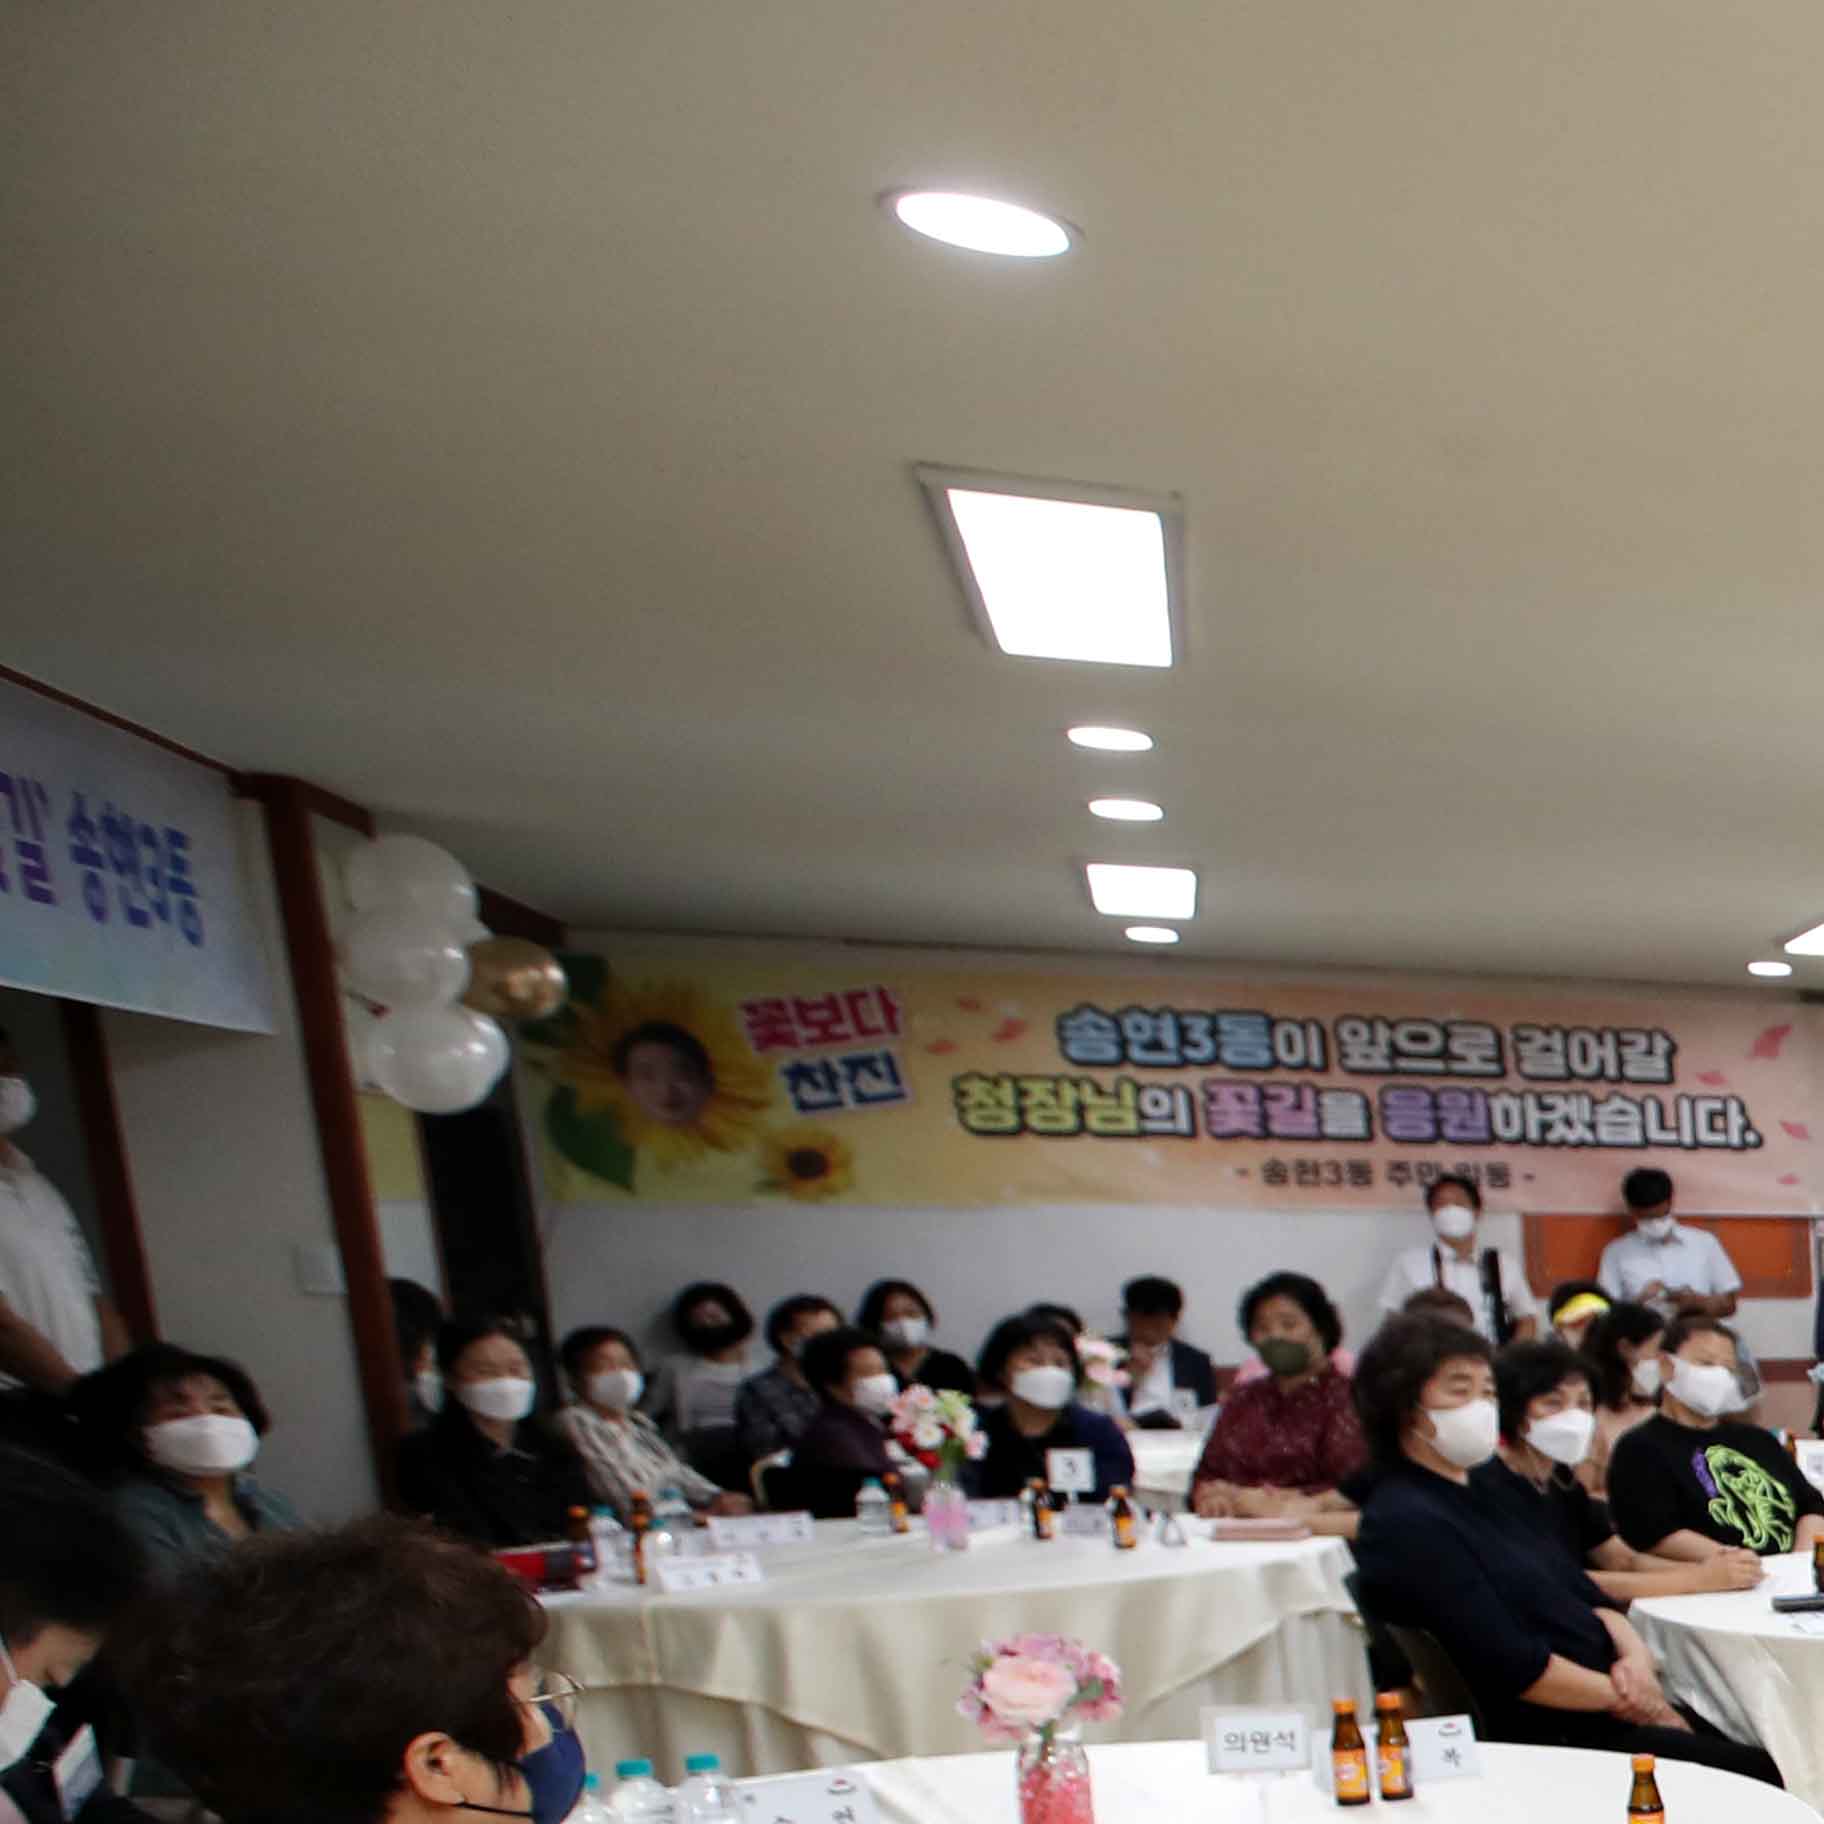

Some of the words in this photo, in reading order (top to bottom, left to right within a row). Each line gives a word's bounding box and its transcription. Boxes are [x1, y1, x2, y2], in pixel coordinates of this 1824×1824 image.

[738, 984, 901, 1052] 꽃보다
[1057, 1002, 1329, 1071] 송현3동이
[1334, 1015, 1506, 1078] 앞으로
[1511, 1022, 1677, 1085] 걸어갈
[781, 1050, 908, 1113] 찬진
[952, 1072, 1196, 1138] 청장님의
[1202, 1079, 1374, 1140] 꽃길을
[1379, 1085, 1764, 1149] 응원하겠습니다.
[1222, 1730, 1297, 1753] 의원석
